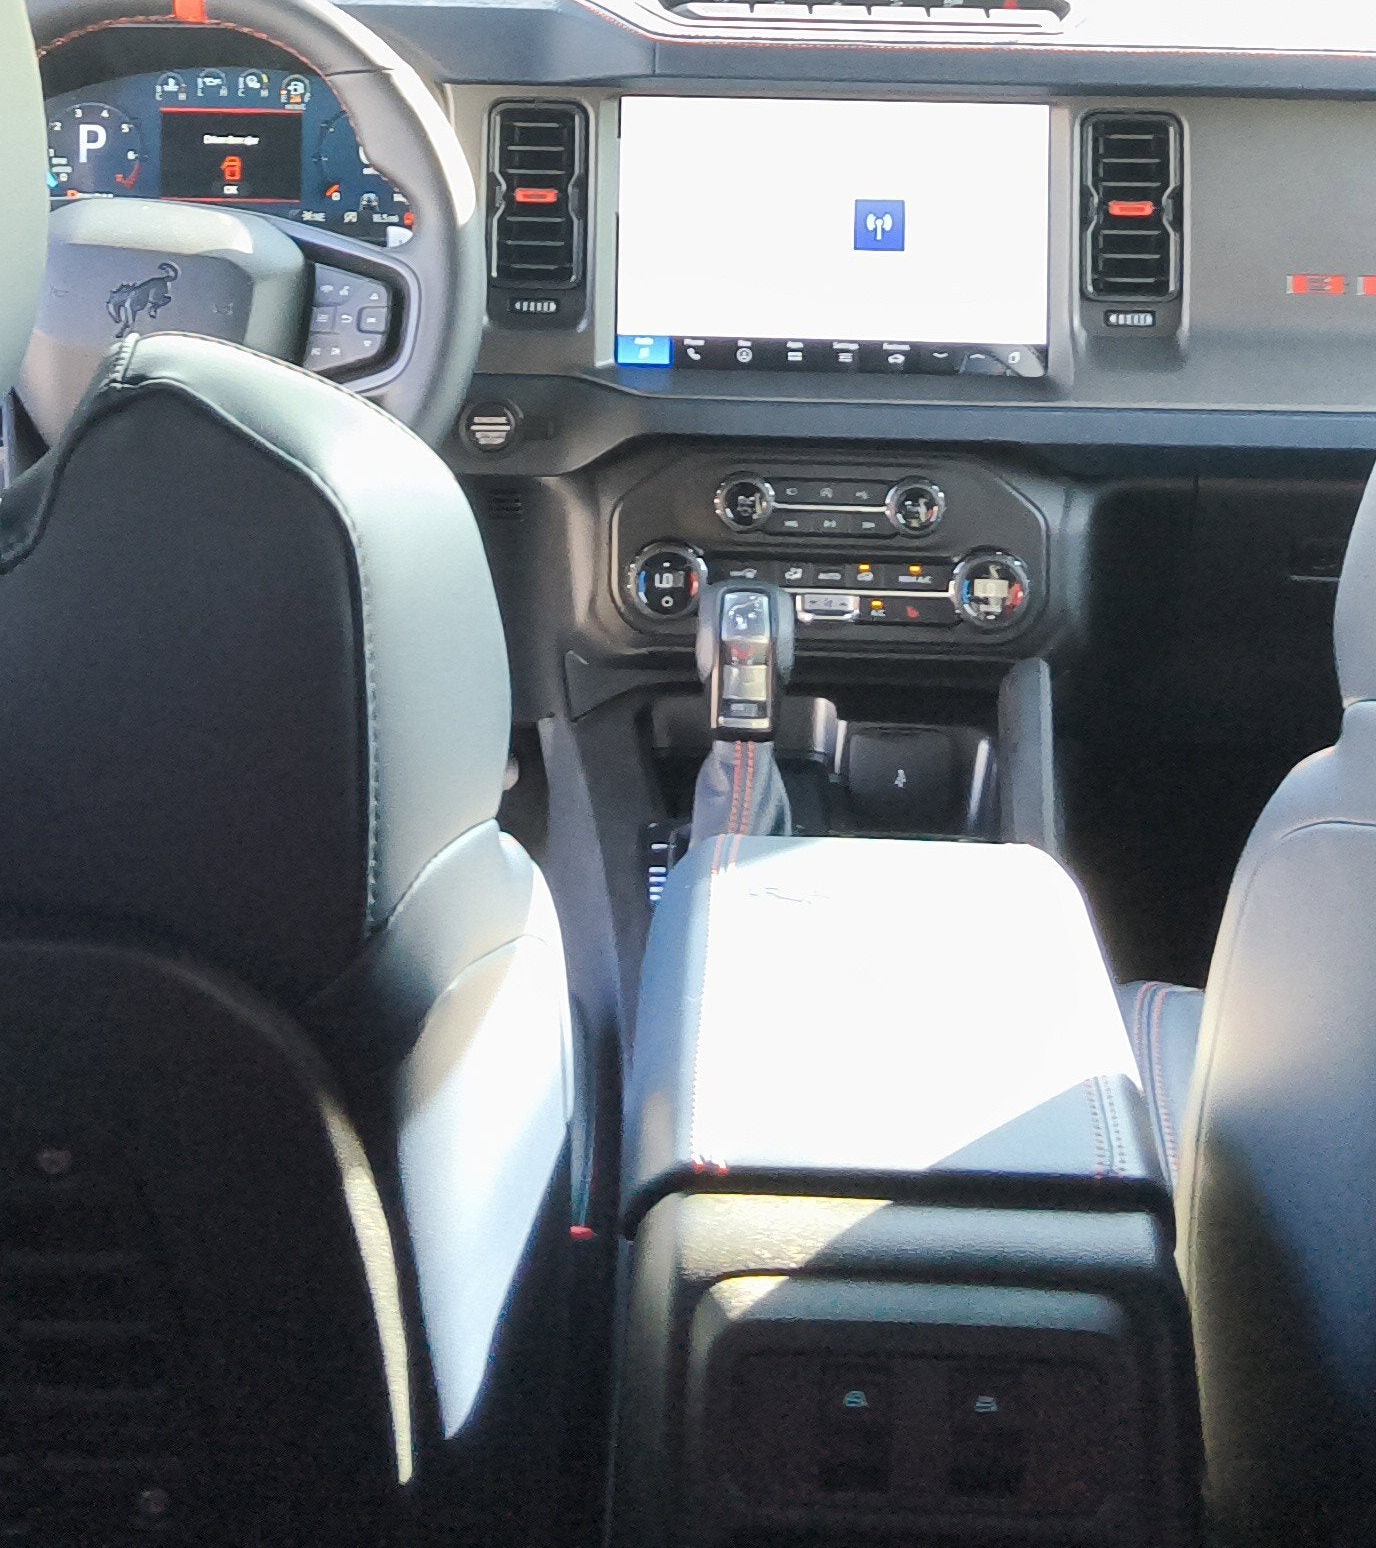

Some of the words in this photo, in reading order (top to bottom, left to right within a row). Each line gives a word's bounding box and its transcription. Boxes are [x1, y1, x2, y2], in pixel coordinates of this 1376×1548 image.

[74, 108, 83, 118] 3
[101, 109, 110, 118] 4
[78, 124, 107, 163] P
